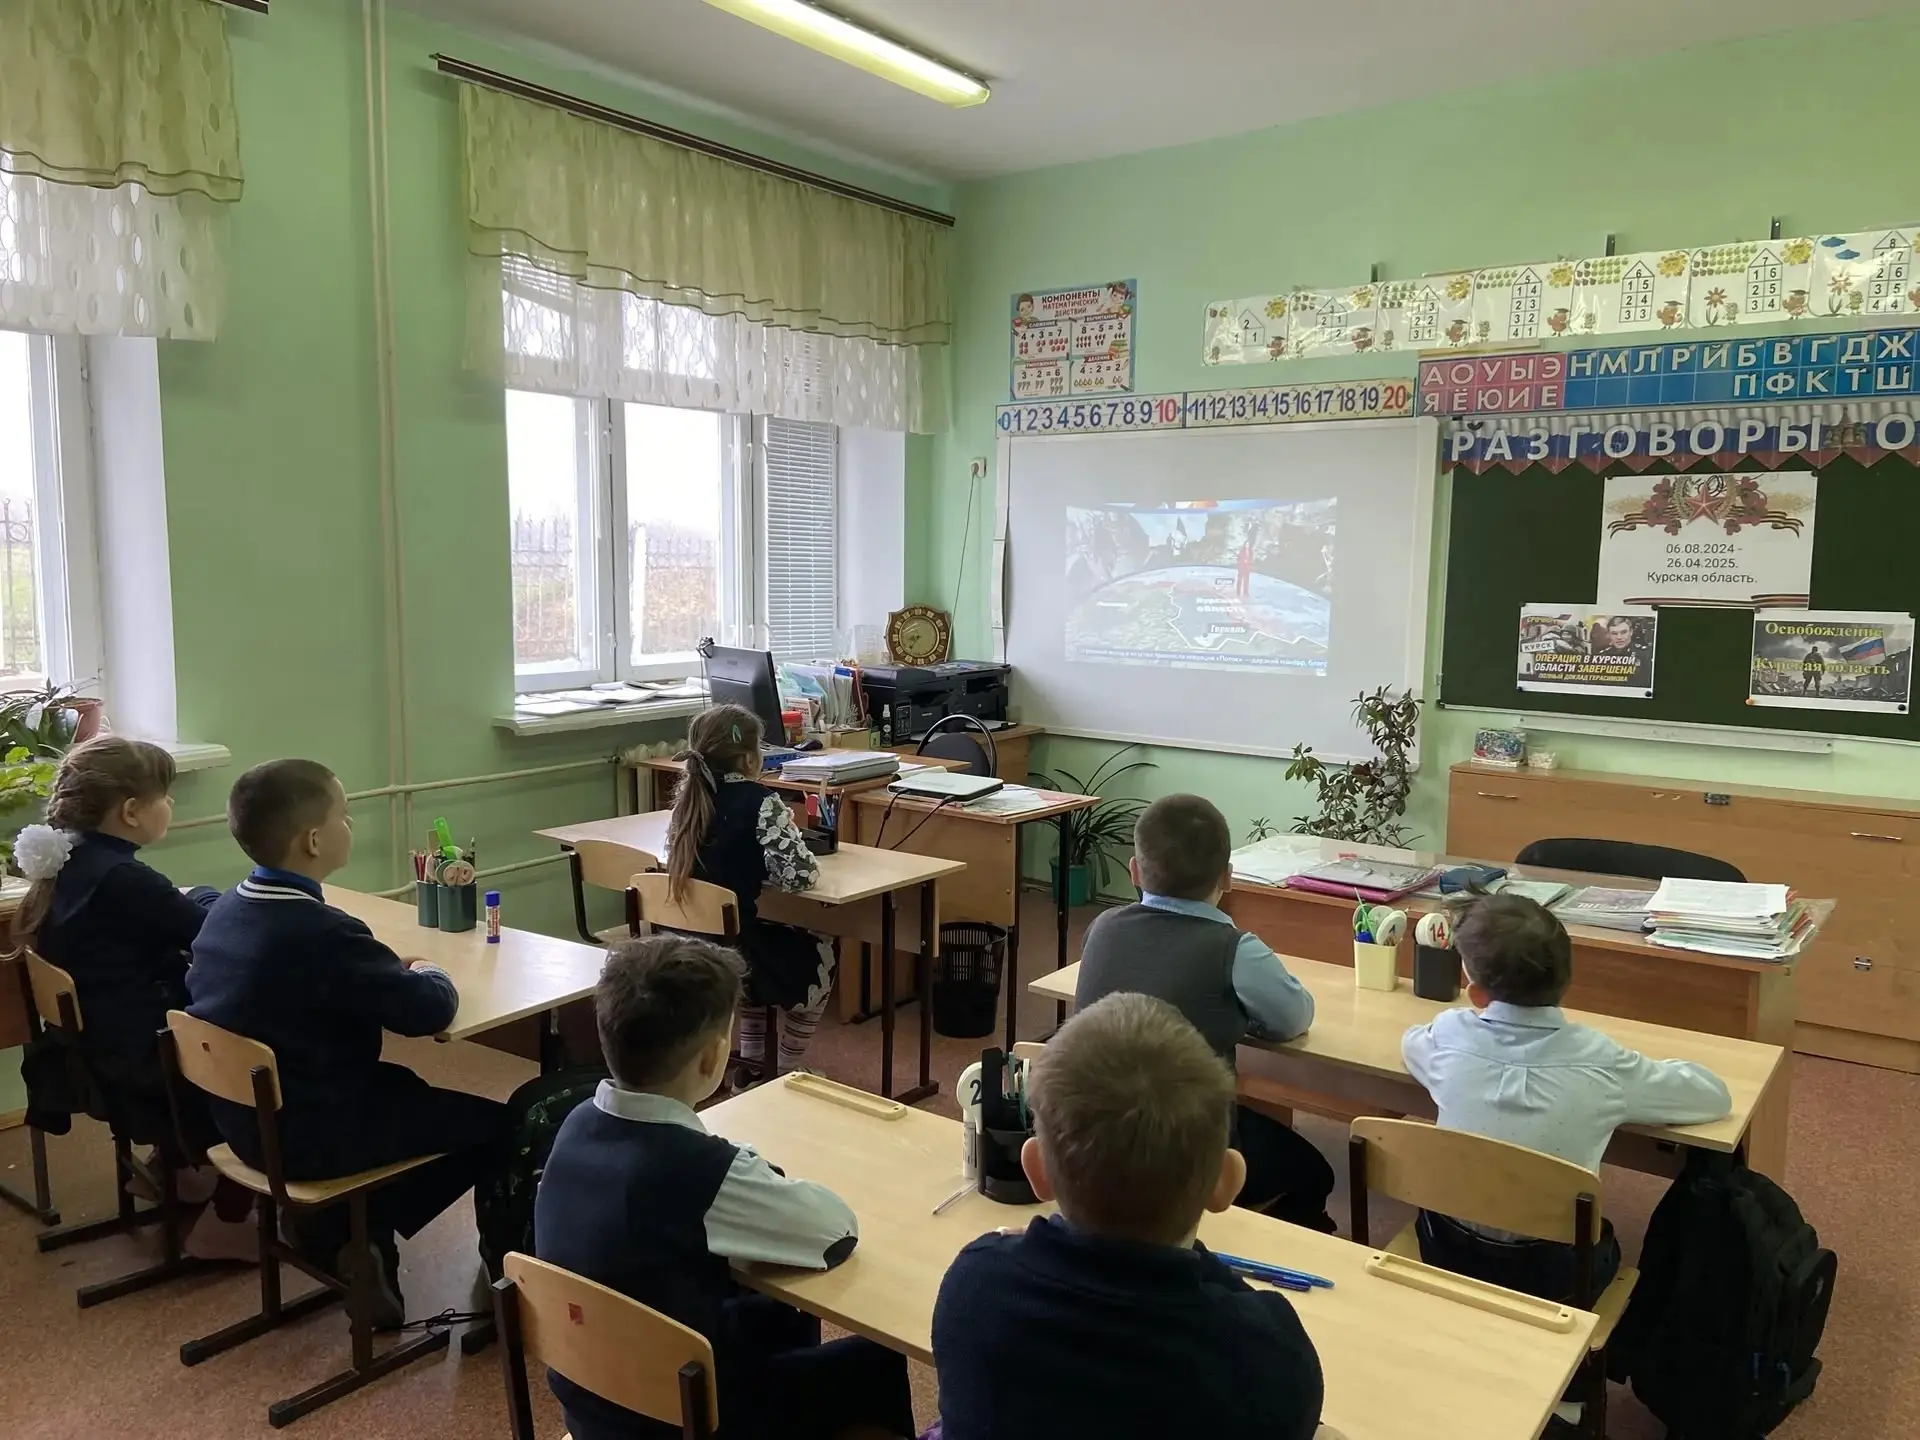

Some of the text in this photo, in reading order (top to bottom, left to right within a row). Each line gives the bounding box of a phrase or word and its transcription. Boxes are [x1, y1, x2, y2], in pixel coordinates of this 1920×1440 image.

[1890, 238, 1896, 248] 8
[1763, 256, 1769, 266] 7
[1898, 251, 1904, 262] 7
[1636, 269, 1642, 278] 6
[1753, 268, 1777, 280] 1 6
[1876, 267, 1902, 278] 2 6
[1525, 275, 1531, 284] 5
[1517, 285, 1538, 296] 1 4
[1628, 280, 1649, 291] 1 5
[1752, 283, 1776, 296] 2 5
[1874, 284, 1900, 294] 3 5
[1042, 290, 1100, 303] КОМПОНЕНТЫ
[1626, 294, 1648, 306] 2 4
[1042, 298, 1099, 310] МАТЕМАТИЧЕСКИХ
[1429, 302, 1436, 311] 3
[1515, 299, 1536, 310] 2 3
[1752, 298, 1775, 310] 3 4
[1872, 300, 1898, 310] 4 4
[1054, 308, 1087, 318] ДЕЙСТВИЙ
[1514, 313, 1535, 324] 3 2
[1624, 308, 1646, 320] 3 3
[1244, 320, 1250, 330] 2
[1321, 316, 1327, 326] 2
[1414, 316, 1434, 326] 2 2
[1082, 326, 1086, 334] 8
[1098, 324, 1104, 332] 5
[1118, 322, 1123, 330] 3
[1335, 329, 1342, 338] 2
[1413, 328, 1432, 339] 3 1
[1512, 327, 1532, 338] 4 1
[1021, 332, 1026, 340] 4
[1039, 330, 1044, 338] 3
[1252, 332, 1258, 342] 1
[1423, 336, 1912, 386] А О У Ы Э Н М Л Р Й Б В Г Д Ж
[1022, 372, 1026, 380] 3
[1423, 366, 1910, 413] Я Ё Ю И Е П Ф К Т Ш
[1191, 385, 1407, 420] 11 12 13 14 15 16 17 18 19 20
[1002, 398, 1177, 431] 0 1 2 3 4 5 6 7 8 9 10
[1451, 413, 1916, 462] РАЗГОВОРЫ О
[1666, 544, 1734, 554] 06.08.2024
[1667, 558, 1738, 568] 26.04.2025.
[1648, 572, 1758, 584] Курская область.
[1535, 653, 1582, 663] ОПЕРАЦИЯ
[1592, 654, 1636, 664] КУРСКОЙ
[1534, 663, 1636, 674] ОБЛАСТИ ЗАВЕРШЕНА!
[1430, 922, 1445, 942] 14
[970, 1079, 982, 1106] 2
